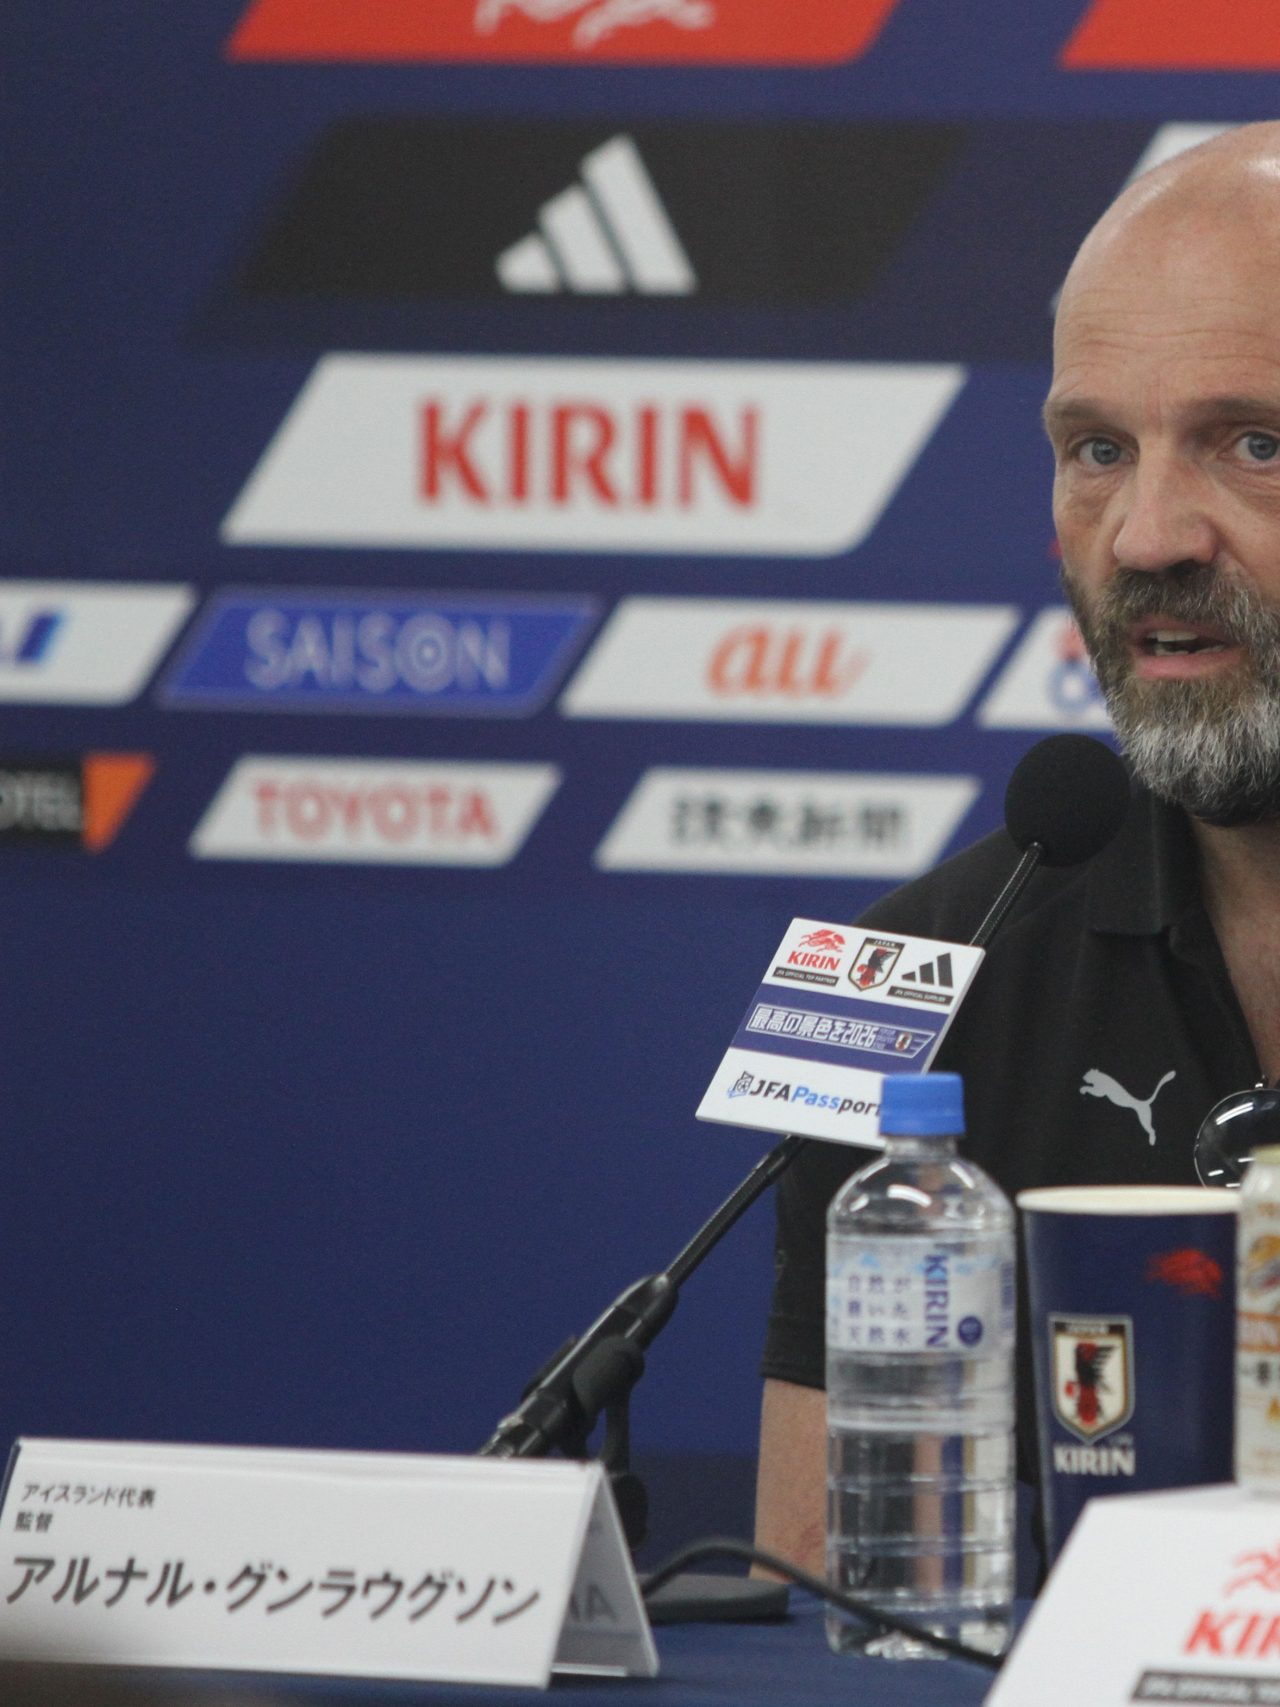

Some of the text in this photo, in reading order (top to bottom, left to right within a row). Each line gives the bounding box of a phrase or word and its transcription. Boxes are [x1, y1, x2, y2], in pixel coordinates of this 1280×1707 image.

[416, 398, 762, 508] KIRIN
[245, 610, 512, 692] SAISON
[705, 622, 866, 698] au
[250, 778, 500, 844] TOYOTA
[786, 950, 841, 972] KIRIN
[873, 939, 898, 949] JAPAN
[924, 1253, 950, 1349] KIRIN
[847, 1326, 911, 1346] 天然水
[1052, 1447, 1137, 1477] KIRIN
[22, 1483, 156, 1510] アイスランド代表
[14, 1511, 53, 1534] 監督
[6, 1555, 542, 1627] アルナル・グンラウグソン
